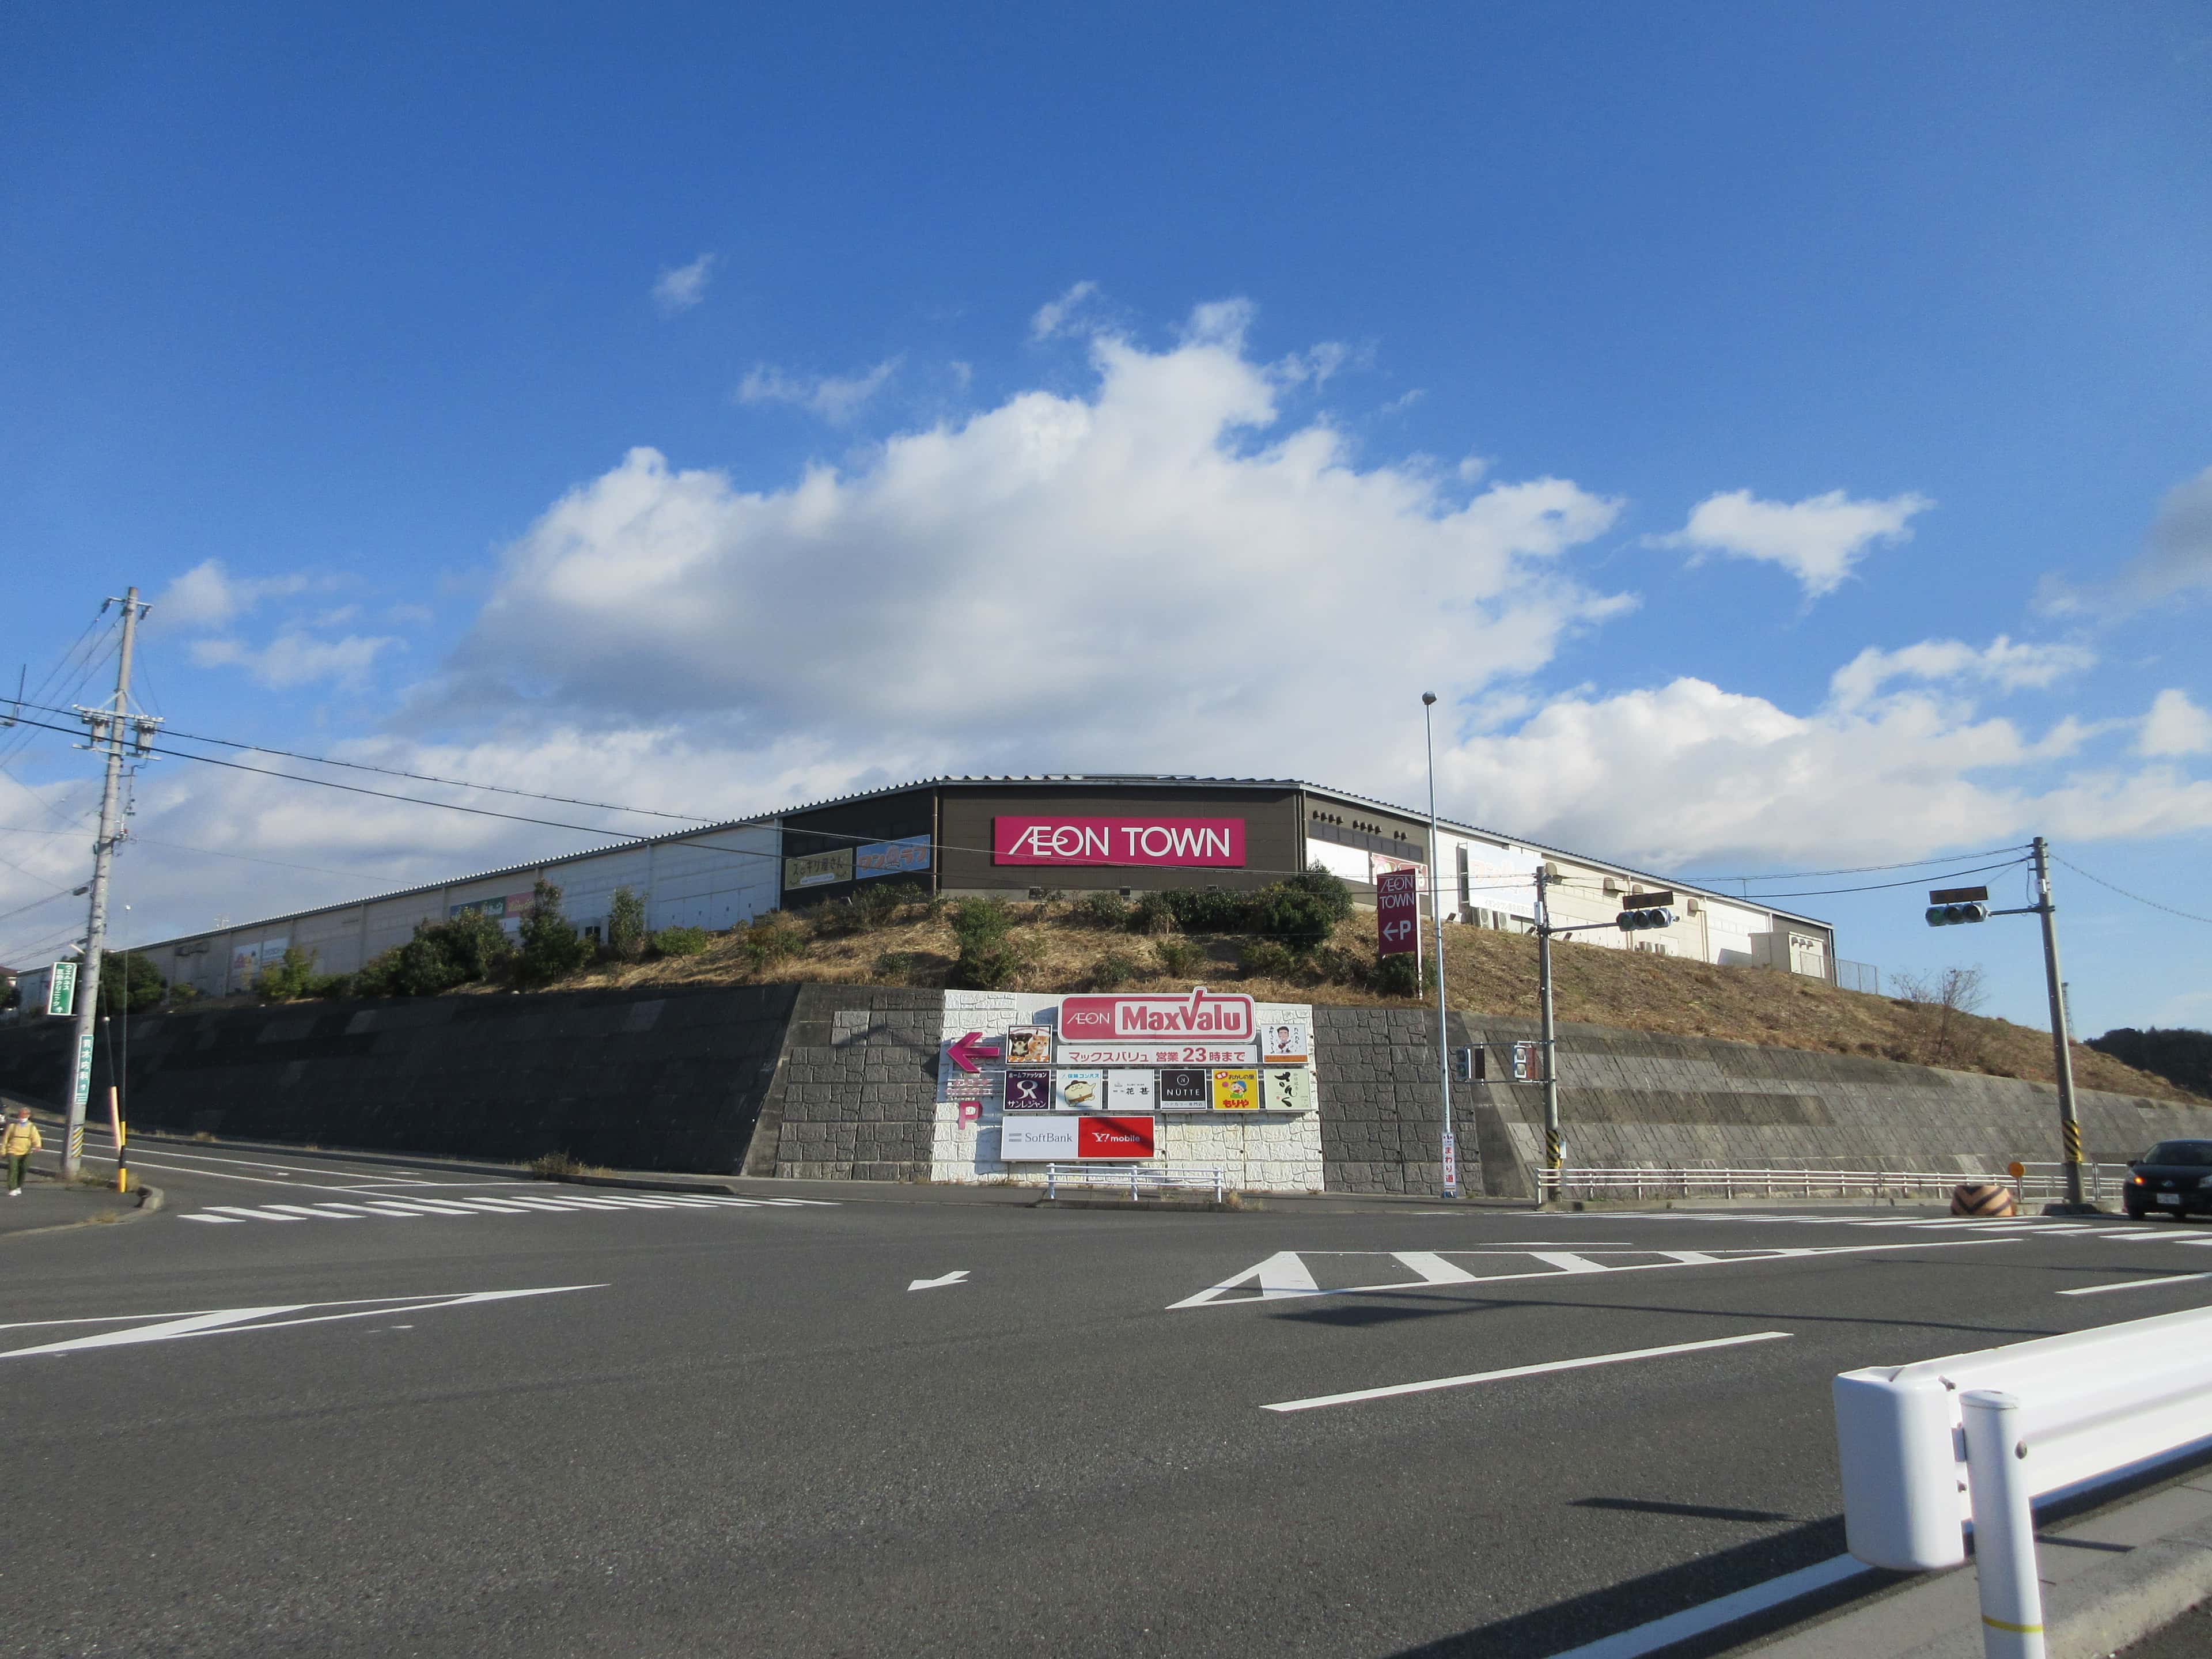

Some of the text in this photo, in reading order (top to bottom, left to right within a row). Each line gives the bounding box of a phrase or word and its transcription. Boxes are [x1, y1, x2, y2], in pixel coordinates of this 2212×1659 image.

[1121, 827, 1230, 857] TOWN
[1380, 892, 1415, 910] TOWN
[1400, 920, 1411, 940] P
[1123, 990, 1240, 1031] MaxValu
[1069, 1051, 1149, 1062] マックスバリュ
[1166, 1088, 1200, 1096] NÜTTE
[1007, 1100, 1047, 1108] サンレジャン
[1223, 1099, 1249, 1108] もりや
[959, 1101, 983, 1130] P
[1025, 1132, 1073, 1142] SoftBank
[1445, 1146, 1454, 1183] まわり道
